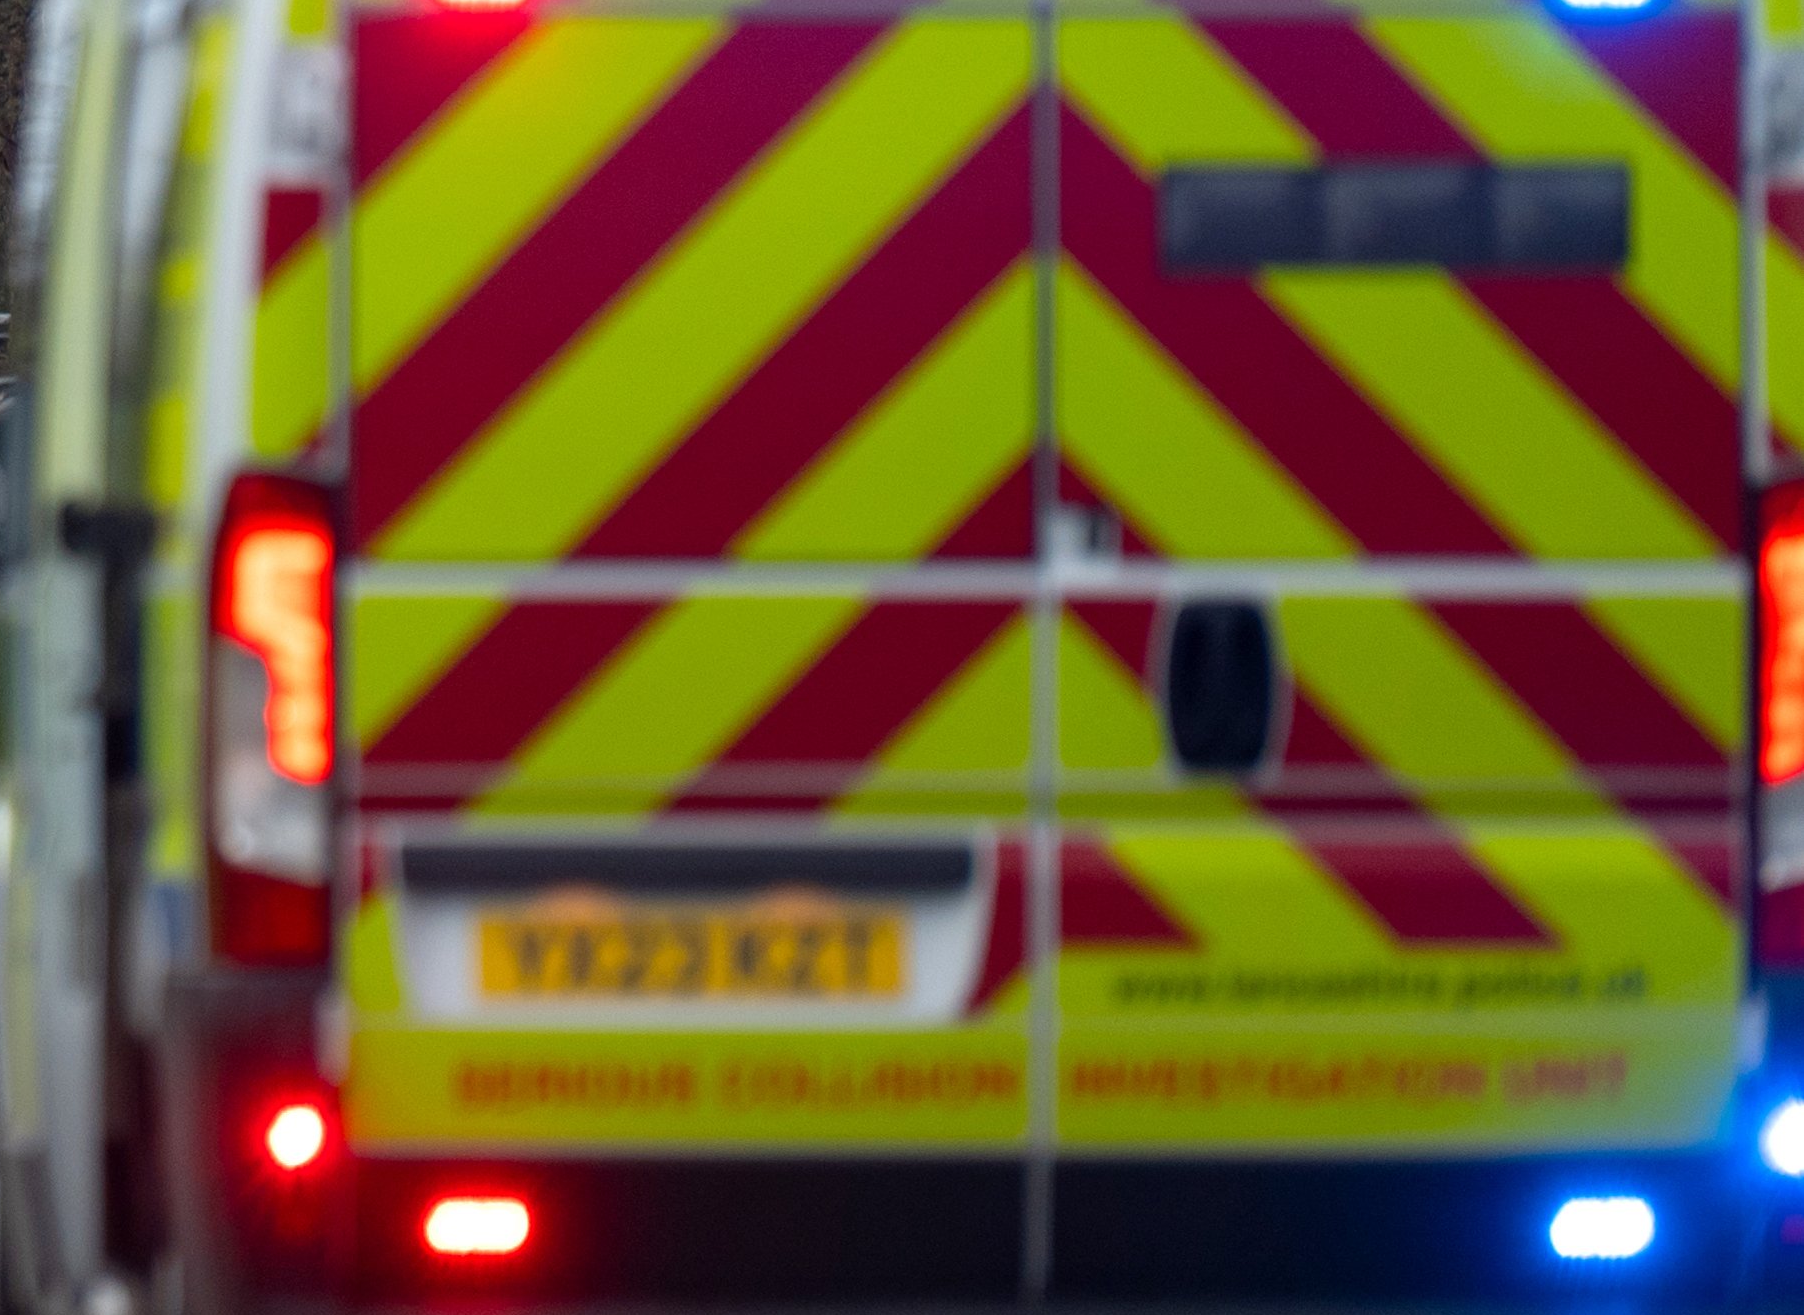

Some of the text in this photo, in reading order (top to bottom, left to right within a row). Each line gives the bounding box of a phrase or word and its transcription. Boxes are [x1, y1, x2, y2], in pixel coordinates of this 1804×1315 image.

[455, 1050, 1631, 1110] SERIOUS COLLISION INVESTIGATION UNIT
